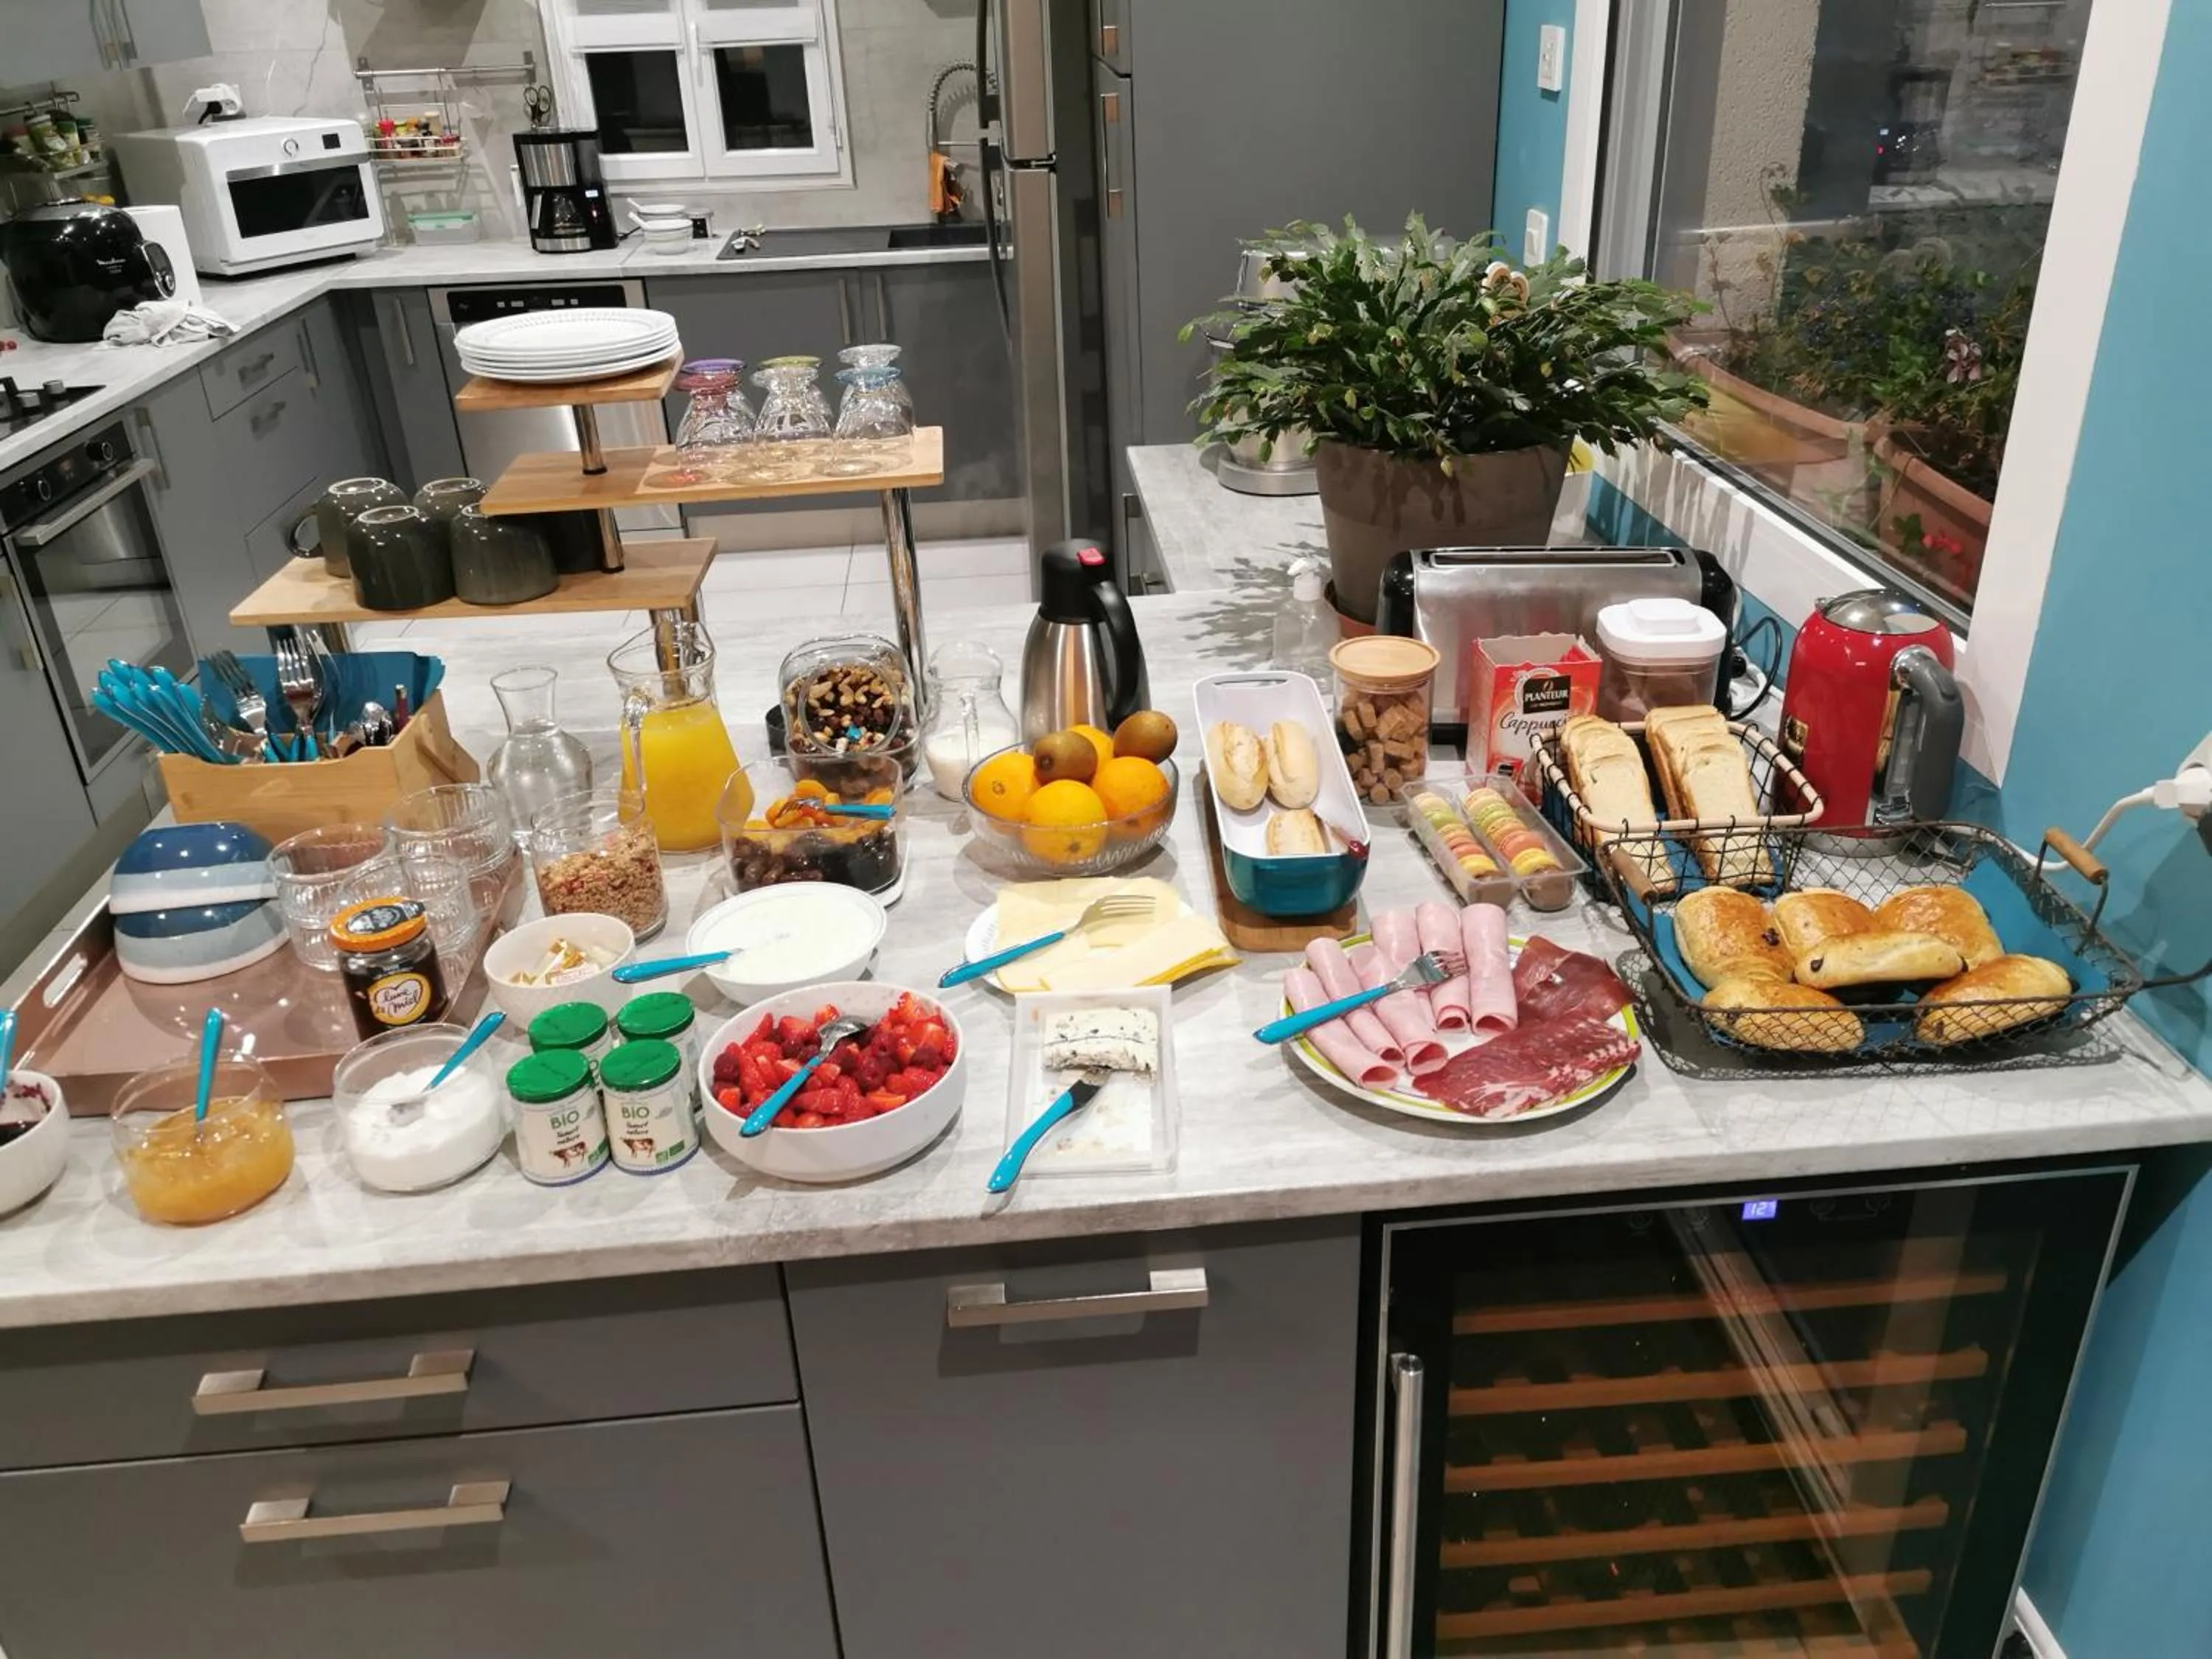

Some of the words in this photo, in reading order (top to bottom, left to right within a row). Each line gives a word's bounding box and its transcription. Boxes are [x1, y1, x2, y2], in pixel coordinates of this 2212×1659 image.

[1524, 689, 1568, 702] PLANTEUR
[550, 1110, 580, 1130] BIO
[622, 1107, 650, 1119] BIO
[1750, 1201, 1768, 1217] 12
